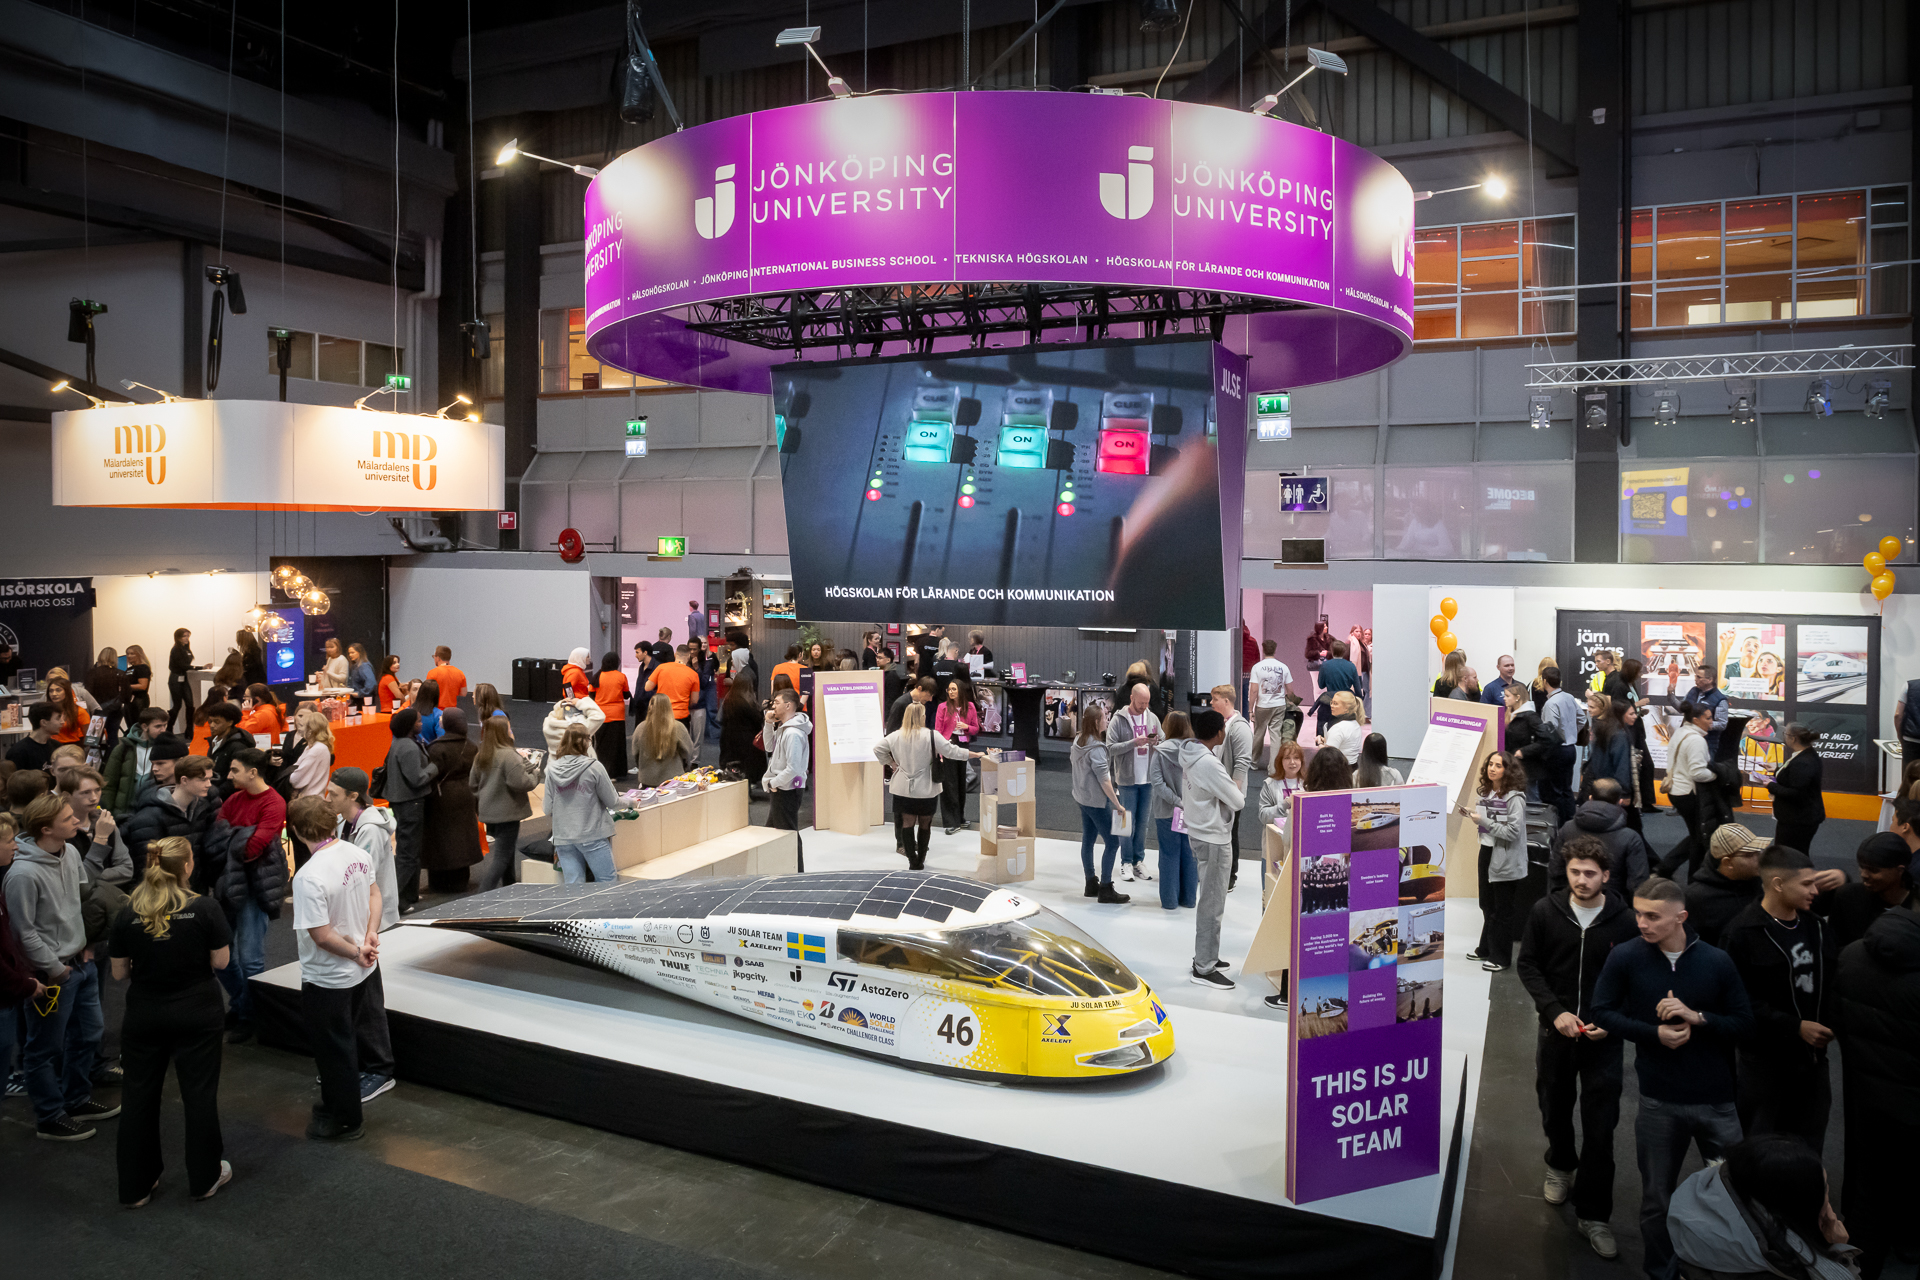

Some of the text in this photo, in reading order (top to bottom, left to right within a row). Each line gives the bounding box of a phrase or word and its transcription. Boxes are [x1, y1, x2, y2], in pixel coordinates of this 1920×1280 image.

[753, 153, 953, 192] JÖNKÖPING
[1173, 160, 1333, 211] JÖNKÖPING
[752, 186, 953, 223] UNIVERSITY
[1173, 194, 1333, 241] UNIVERSITY
[632, 252, 1390, 309] HÄLSOHÖGSKOLAN JÖNKÖPING INTERNATIONAL BUSINESS SCHOOL TEKNISKA HÖGSKOLAN HÖGSKOLAN FÖR LÄRANDE OCH KOMMUNIKATION HÄLSOHÖGSKOLAN
[1221, 367, 1241, 400] JU.SE
[1014, 397, 1041, 405] CUE
[1113, 400, 1143, 409] CUE
[1013, 435, 1032, 443] ON
[1114, 440, 1135, 448] ON
[104, 458, 144, 468] Mälardalens
[358, 460, 410, 472] Mälardalens
[110, 468, 144, 478] universitet
[364, 471, 410, 482] universitet
[825, 585, 1115, 602] HÖGSKOLAN FÖR LÄRANDE OCH KOMMUNIKATION
[30, 598, 50, 608] HOS
[52, 598, 75, 606] OSS!
[1576, 628, 1610, 646] järn
[1580, 656, 1600, 674] jo
[1830, 733, 1852, 741] MED
[1824, 742, 1859, 750] FLYTTA
[1816, 751, 1854, 760] VERIGE!
[608, 932, 638, 940] wiretronic
[727, 926, 783, 942] JU SOLAR TEAM
[628, 945, 661, 955] GRUPPEN
[750, 942, 783, 952] AXELENT
[666, 948, 696, 960] Ansys
[660, 959, 691, 972] THULE
[695, 965, 729, 976] TECHNIA
[861, 983, 910, 1000] AstaZero
[797, 1010, 816, 1020] EKO
[870, 1012, 896, 1024] WORLD
[820, 1022, 846, 1032] PROJECTA
[869, 1019, 895, 1030] SOLAR
[936, 1013, 974, 1047] 46
[847, 1028, 895, 1046] CHALLENGER CLASS
[869, 1026, 895, 1036] CHALLENGE
[1311, 1057, 1429, 1099] THIS IS JU
[1331, 1093, 1409, 1128] SOLAR
[1337, 1126, 1402, 1159] TEAM
